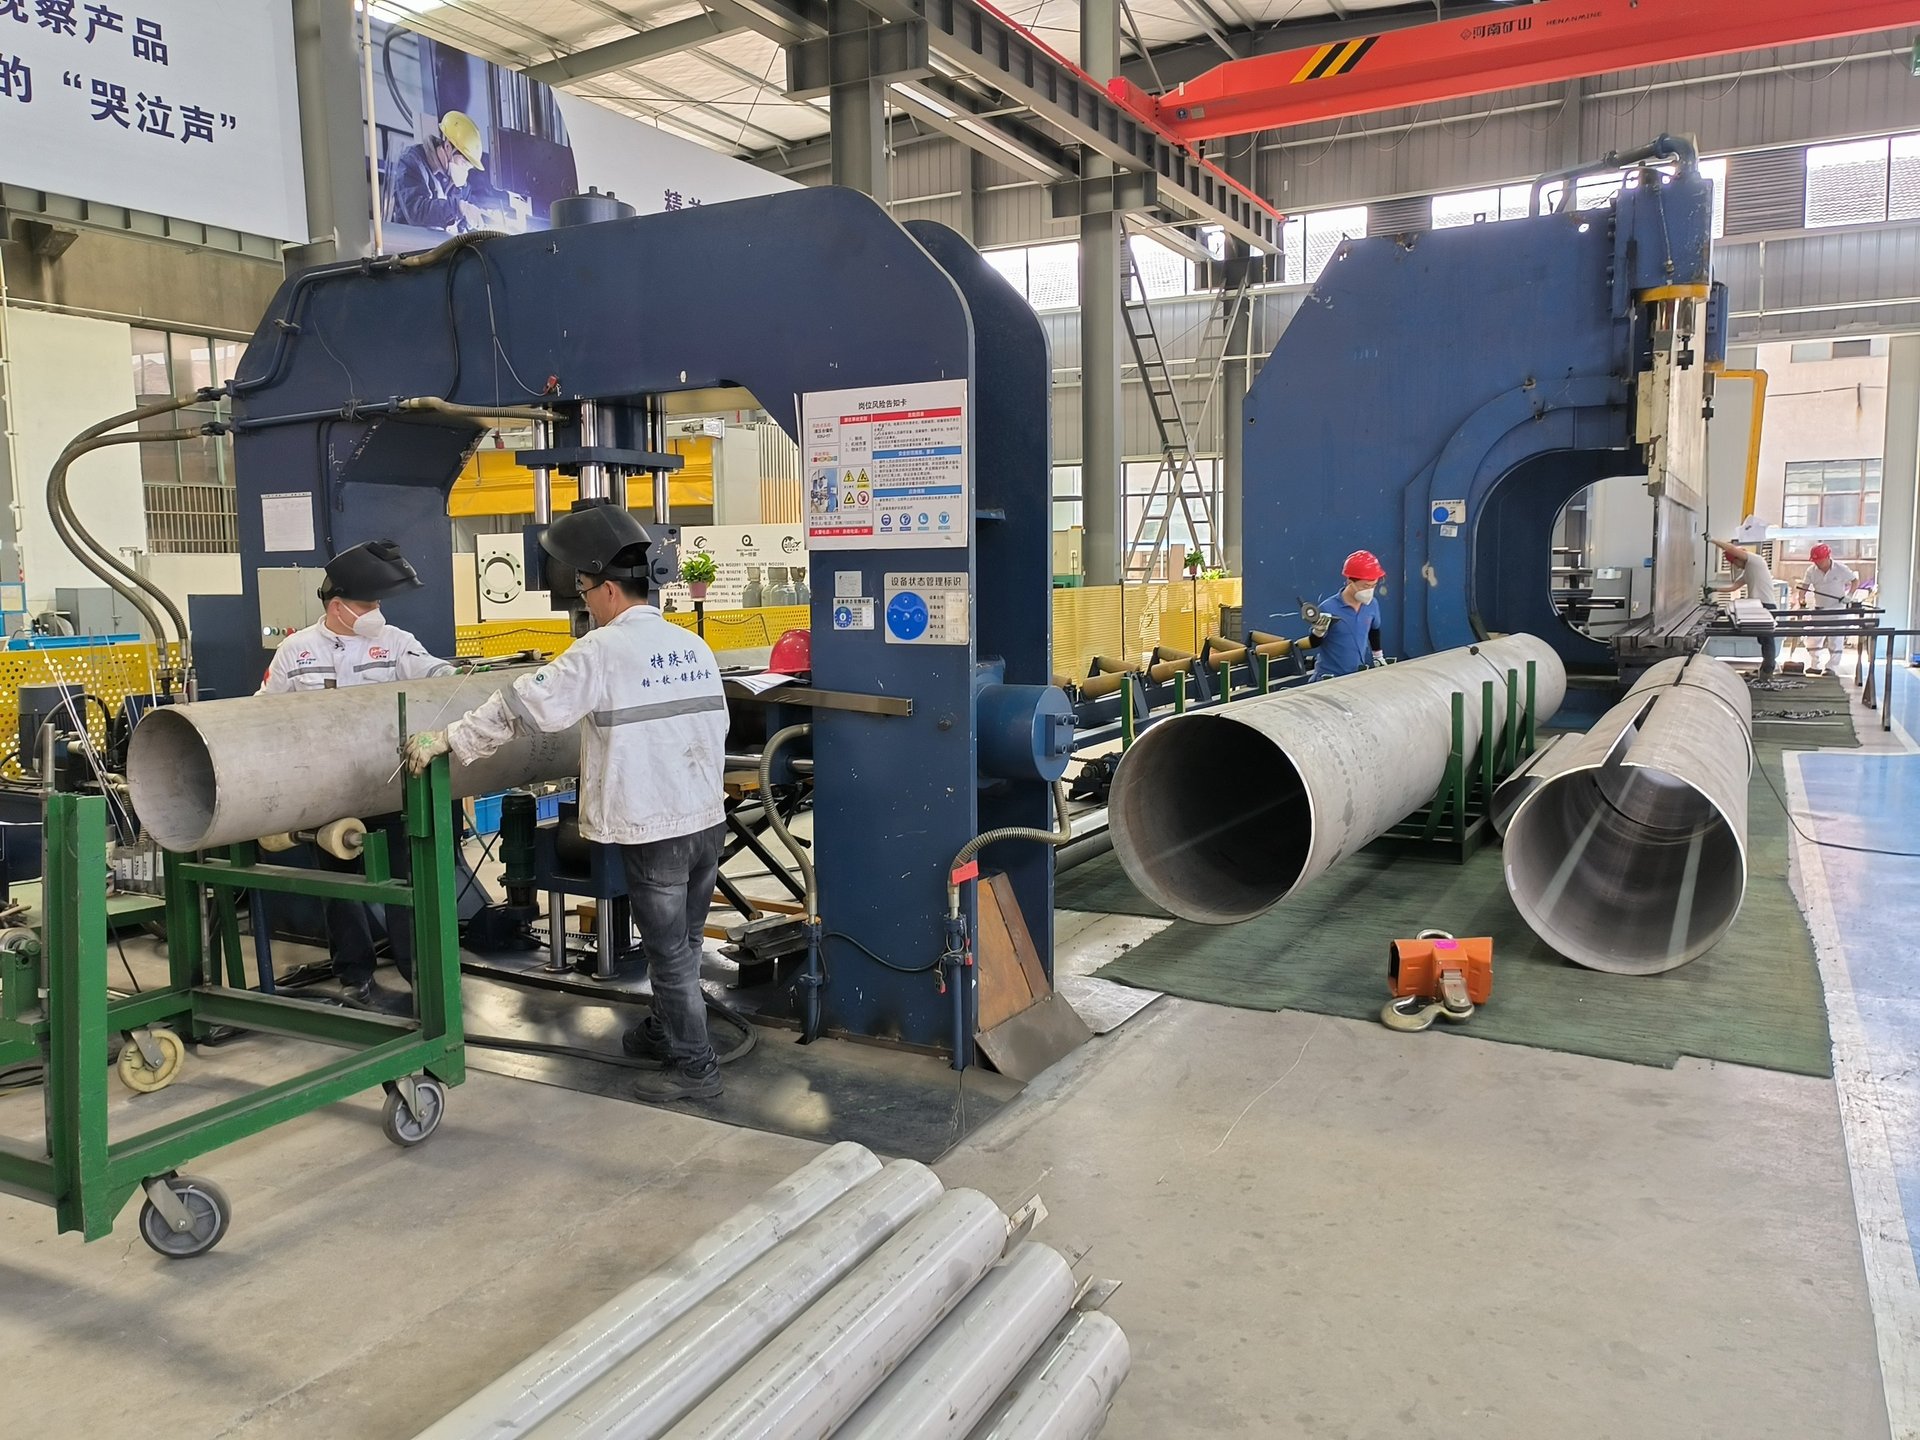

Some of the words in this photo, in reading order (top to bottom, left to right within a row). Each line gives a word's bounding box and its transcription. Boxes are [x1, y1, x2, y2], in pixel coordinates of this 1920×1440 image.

[1473, 17, 1532, 39] 河南矿山
[1546, 11, 1603, 26] HENANMINE
[858, 399, 908, 411] 岗位风险告知卡
[891, 576, 961, 587] 设备状态管理标识
[651, 649, 698, 669] 特殊钢
